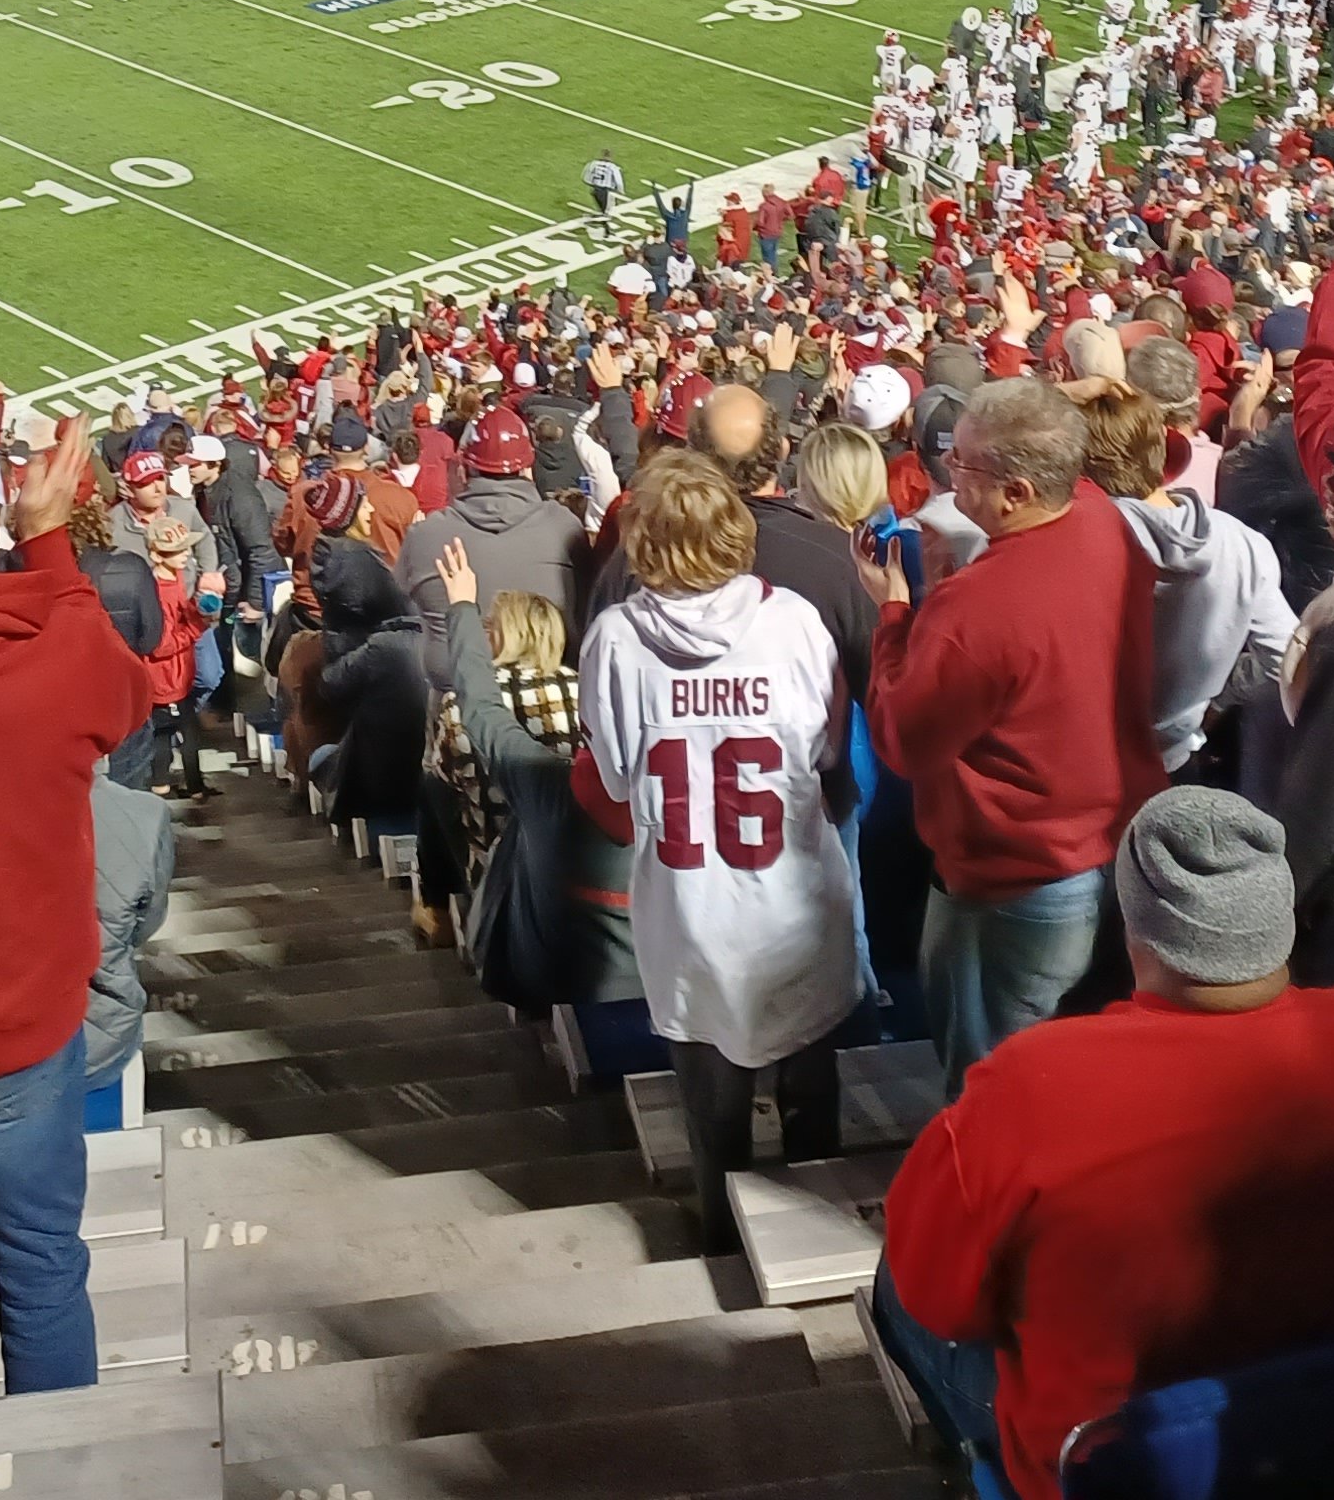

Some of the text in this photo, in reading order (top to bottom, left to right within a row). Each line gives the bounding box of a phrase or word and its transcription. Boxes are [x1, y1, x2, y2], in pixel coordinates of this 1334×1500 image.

[406, 60, 562, 111] 20
[21, 156, 195, 216] 10
[672, 676, 770, 718] BURKS
[648, 736, 784, 870] 16
